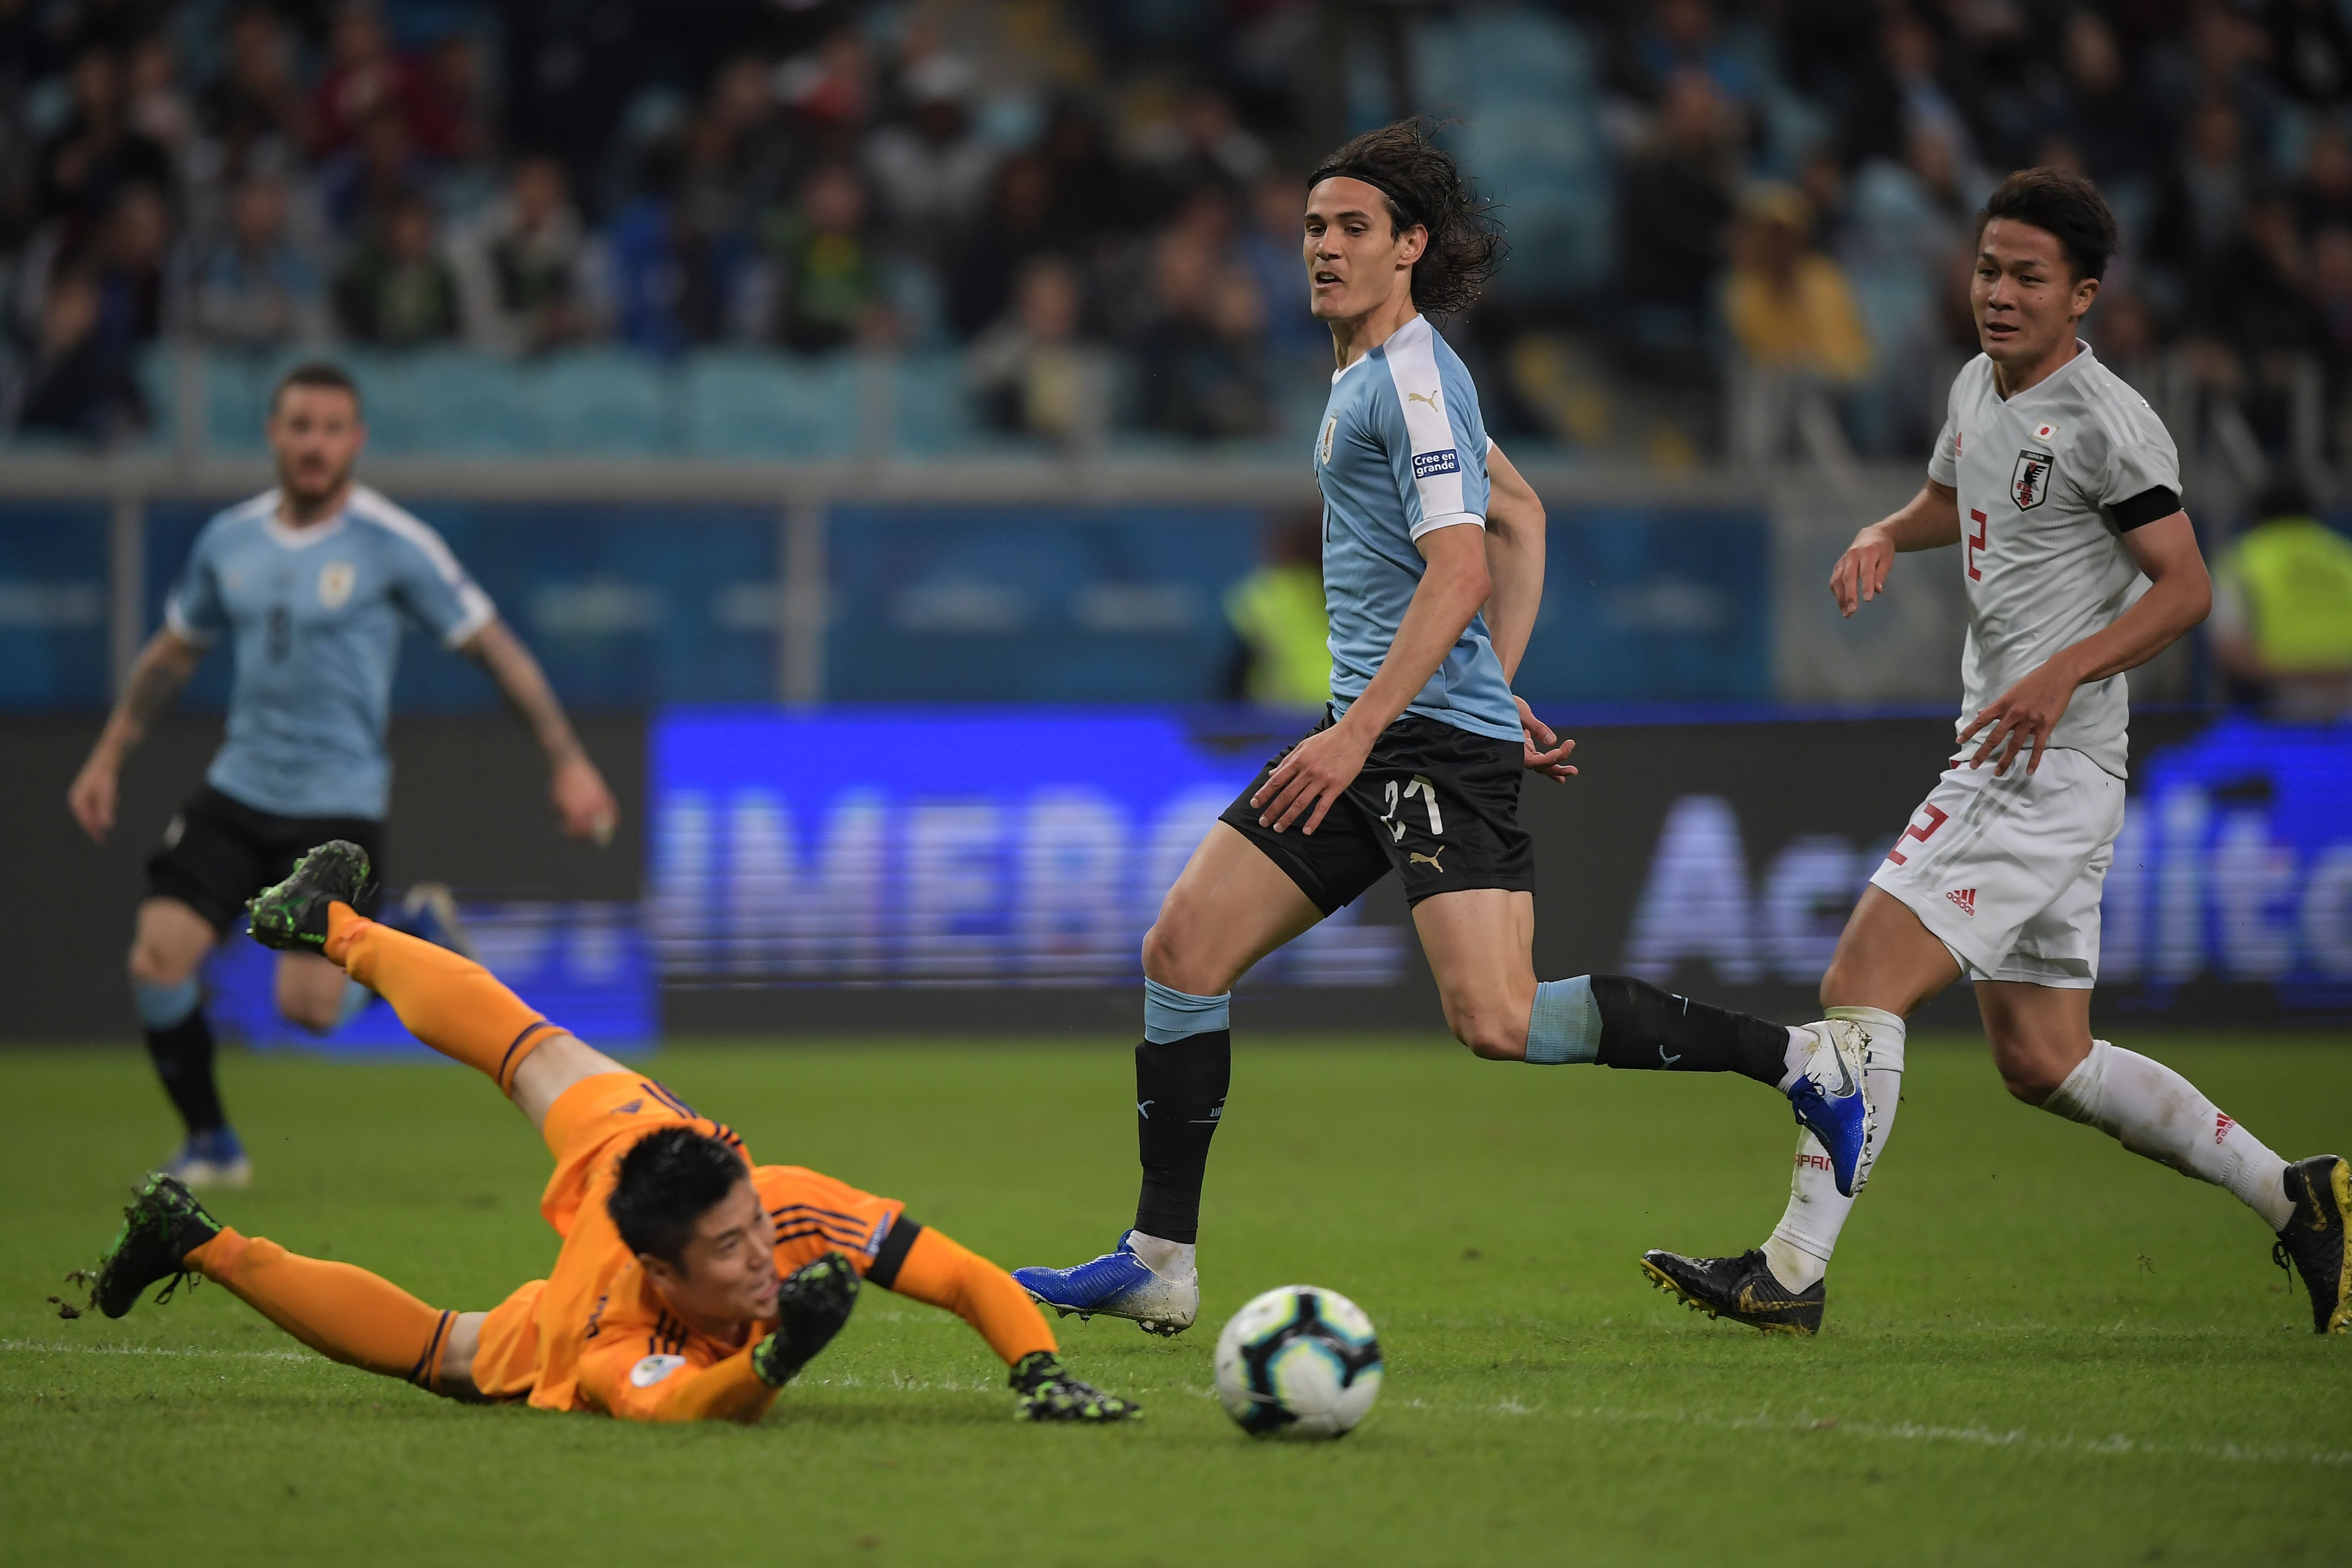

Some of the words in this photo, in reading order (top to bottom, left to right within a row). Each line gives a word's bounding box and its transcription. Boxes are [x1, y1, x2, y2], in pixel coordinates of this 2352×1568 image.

[1414, 455, 1440, 466] Cree
[1416, 461, 1455, 477] grande
[1969, 508, 1987, 582] 2
[1380, 774, 1443, 843] 21
[1886, 803, 1949, 866] 2
[1946, 892, 1975, 916] adidas
